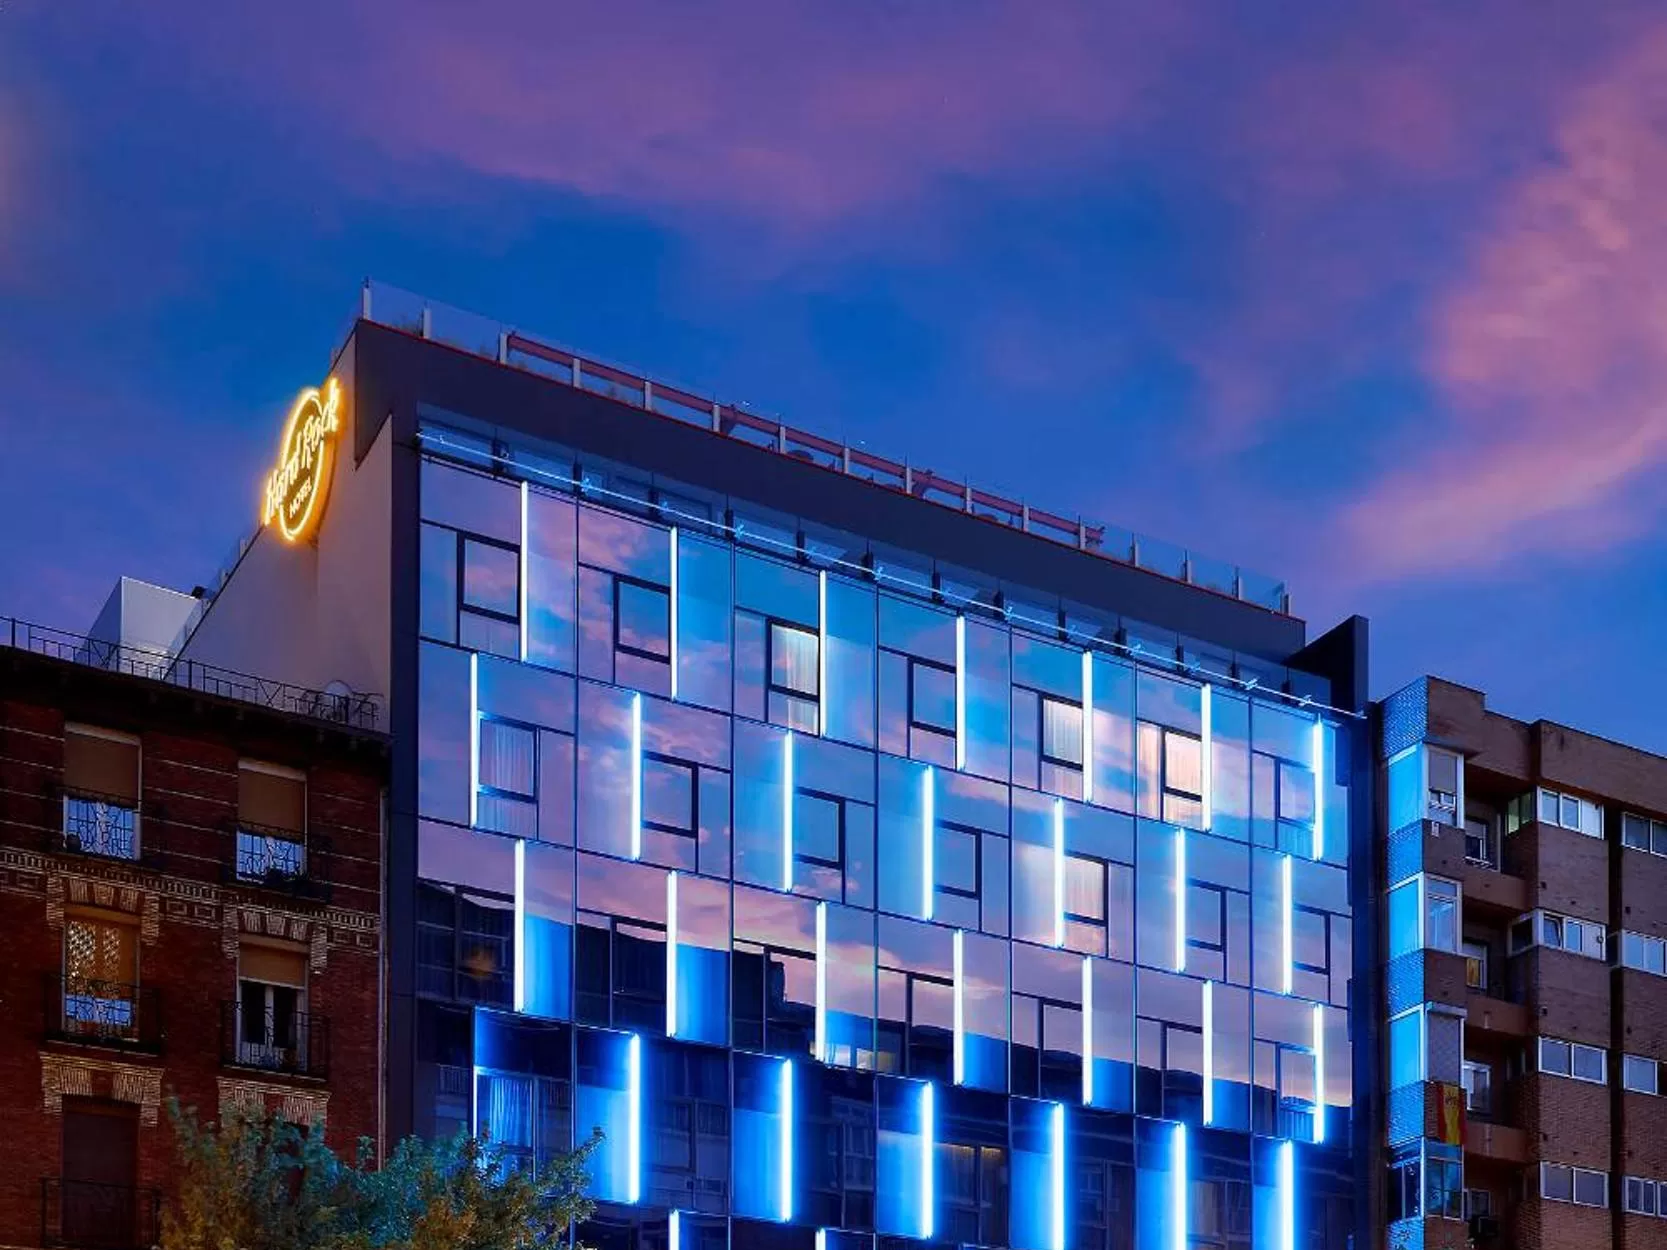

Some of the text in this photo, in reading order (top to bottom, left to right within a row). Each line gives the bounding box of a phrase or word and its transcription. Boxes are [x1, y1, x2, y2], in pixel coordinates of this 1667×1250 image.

[264, 376, 340, 526] Hard Rock
[289, 475, 312, 519] HOTEL
